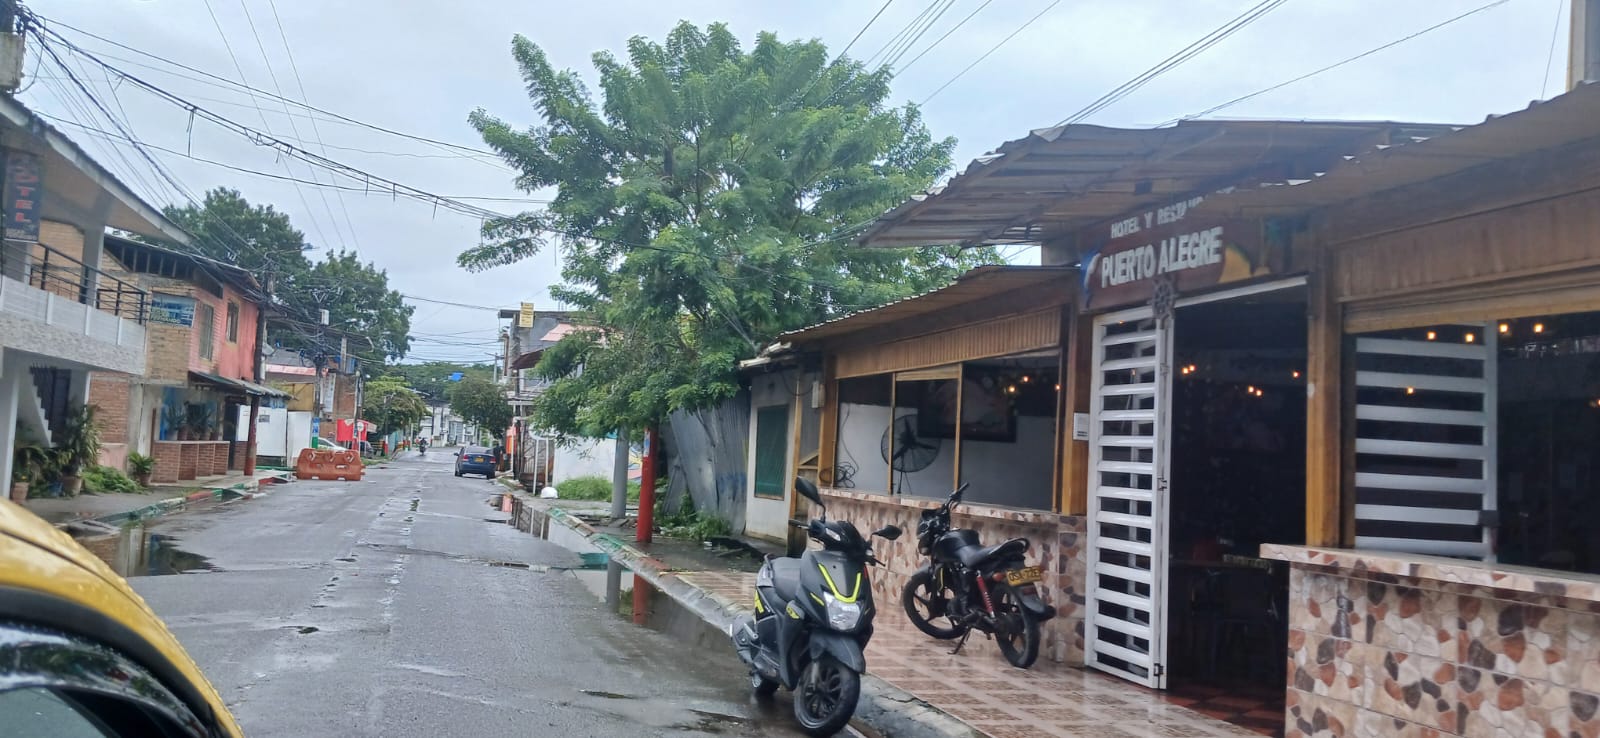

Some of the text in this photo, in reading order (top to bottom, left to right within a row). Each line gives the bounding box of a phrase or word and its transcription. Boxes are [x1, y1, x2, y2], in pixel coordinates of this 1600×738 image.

[1111, 217, 1141, 238] HOTEL
[1143, 211, 1154, 229] Y
[1101, 226, 1224, 288] PUERTO ALEGRE
